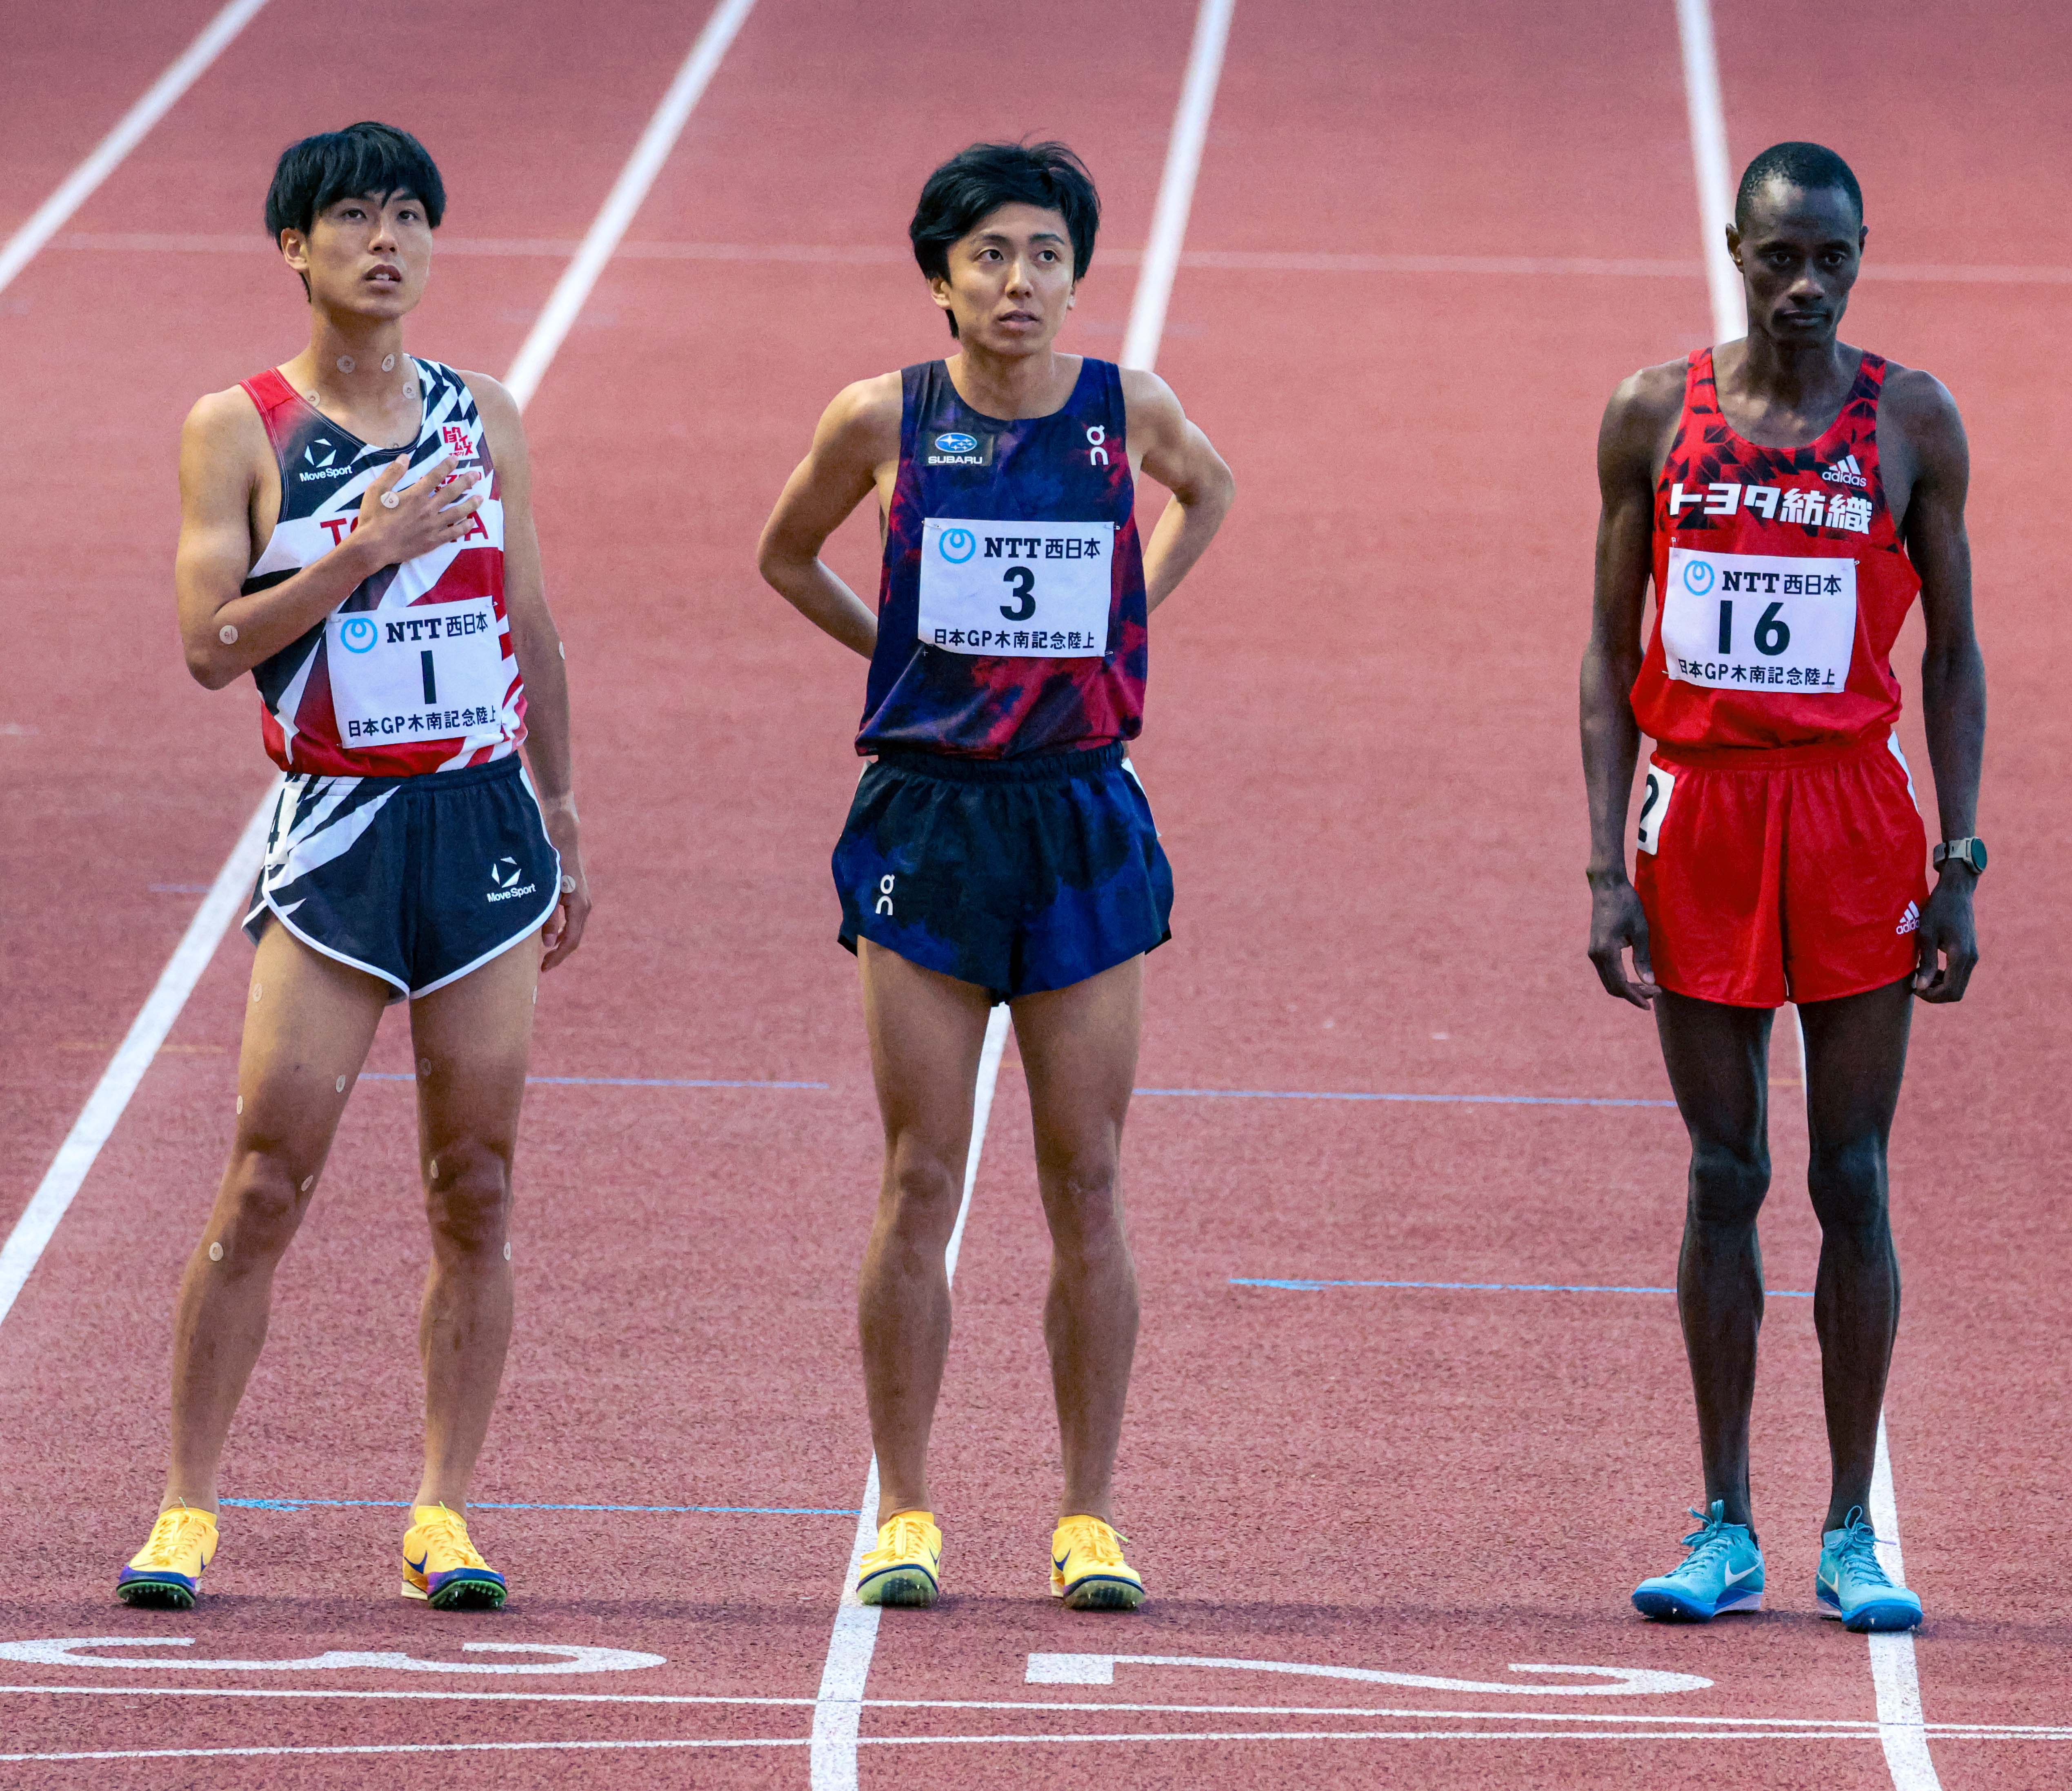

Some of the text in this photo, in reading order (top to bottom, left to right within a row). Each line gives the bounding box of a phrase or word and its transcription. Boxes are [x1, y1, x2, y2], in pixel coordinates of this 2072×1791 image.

[928, 456, 983, 464] SUBARU
[1822, 469, 1867, 487] adidas
[1670, 482, 1872, 534] トヨタ紡織
[1000, 566, 1036, 621] 3
[934, 629, 1095, 650] 日本GP木南記念陸上
[1718, 600, 1791, 656] 16
[420, 650, 437, 705] 1
[1678, 659, 1836, 686] 日本GP木南記念陸上
[348, 705, 496, 738] 日本GP木南記念陸上
[1896, 919, 1920, 935] adida
